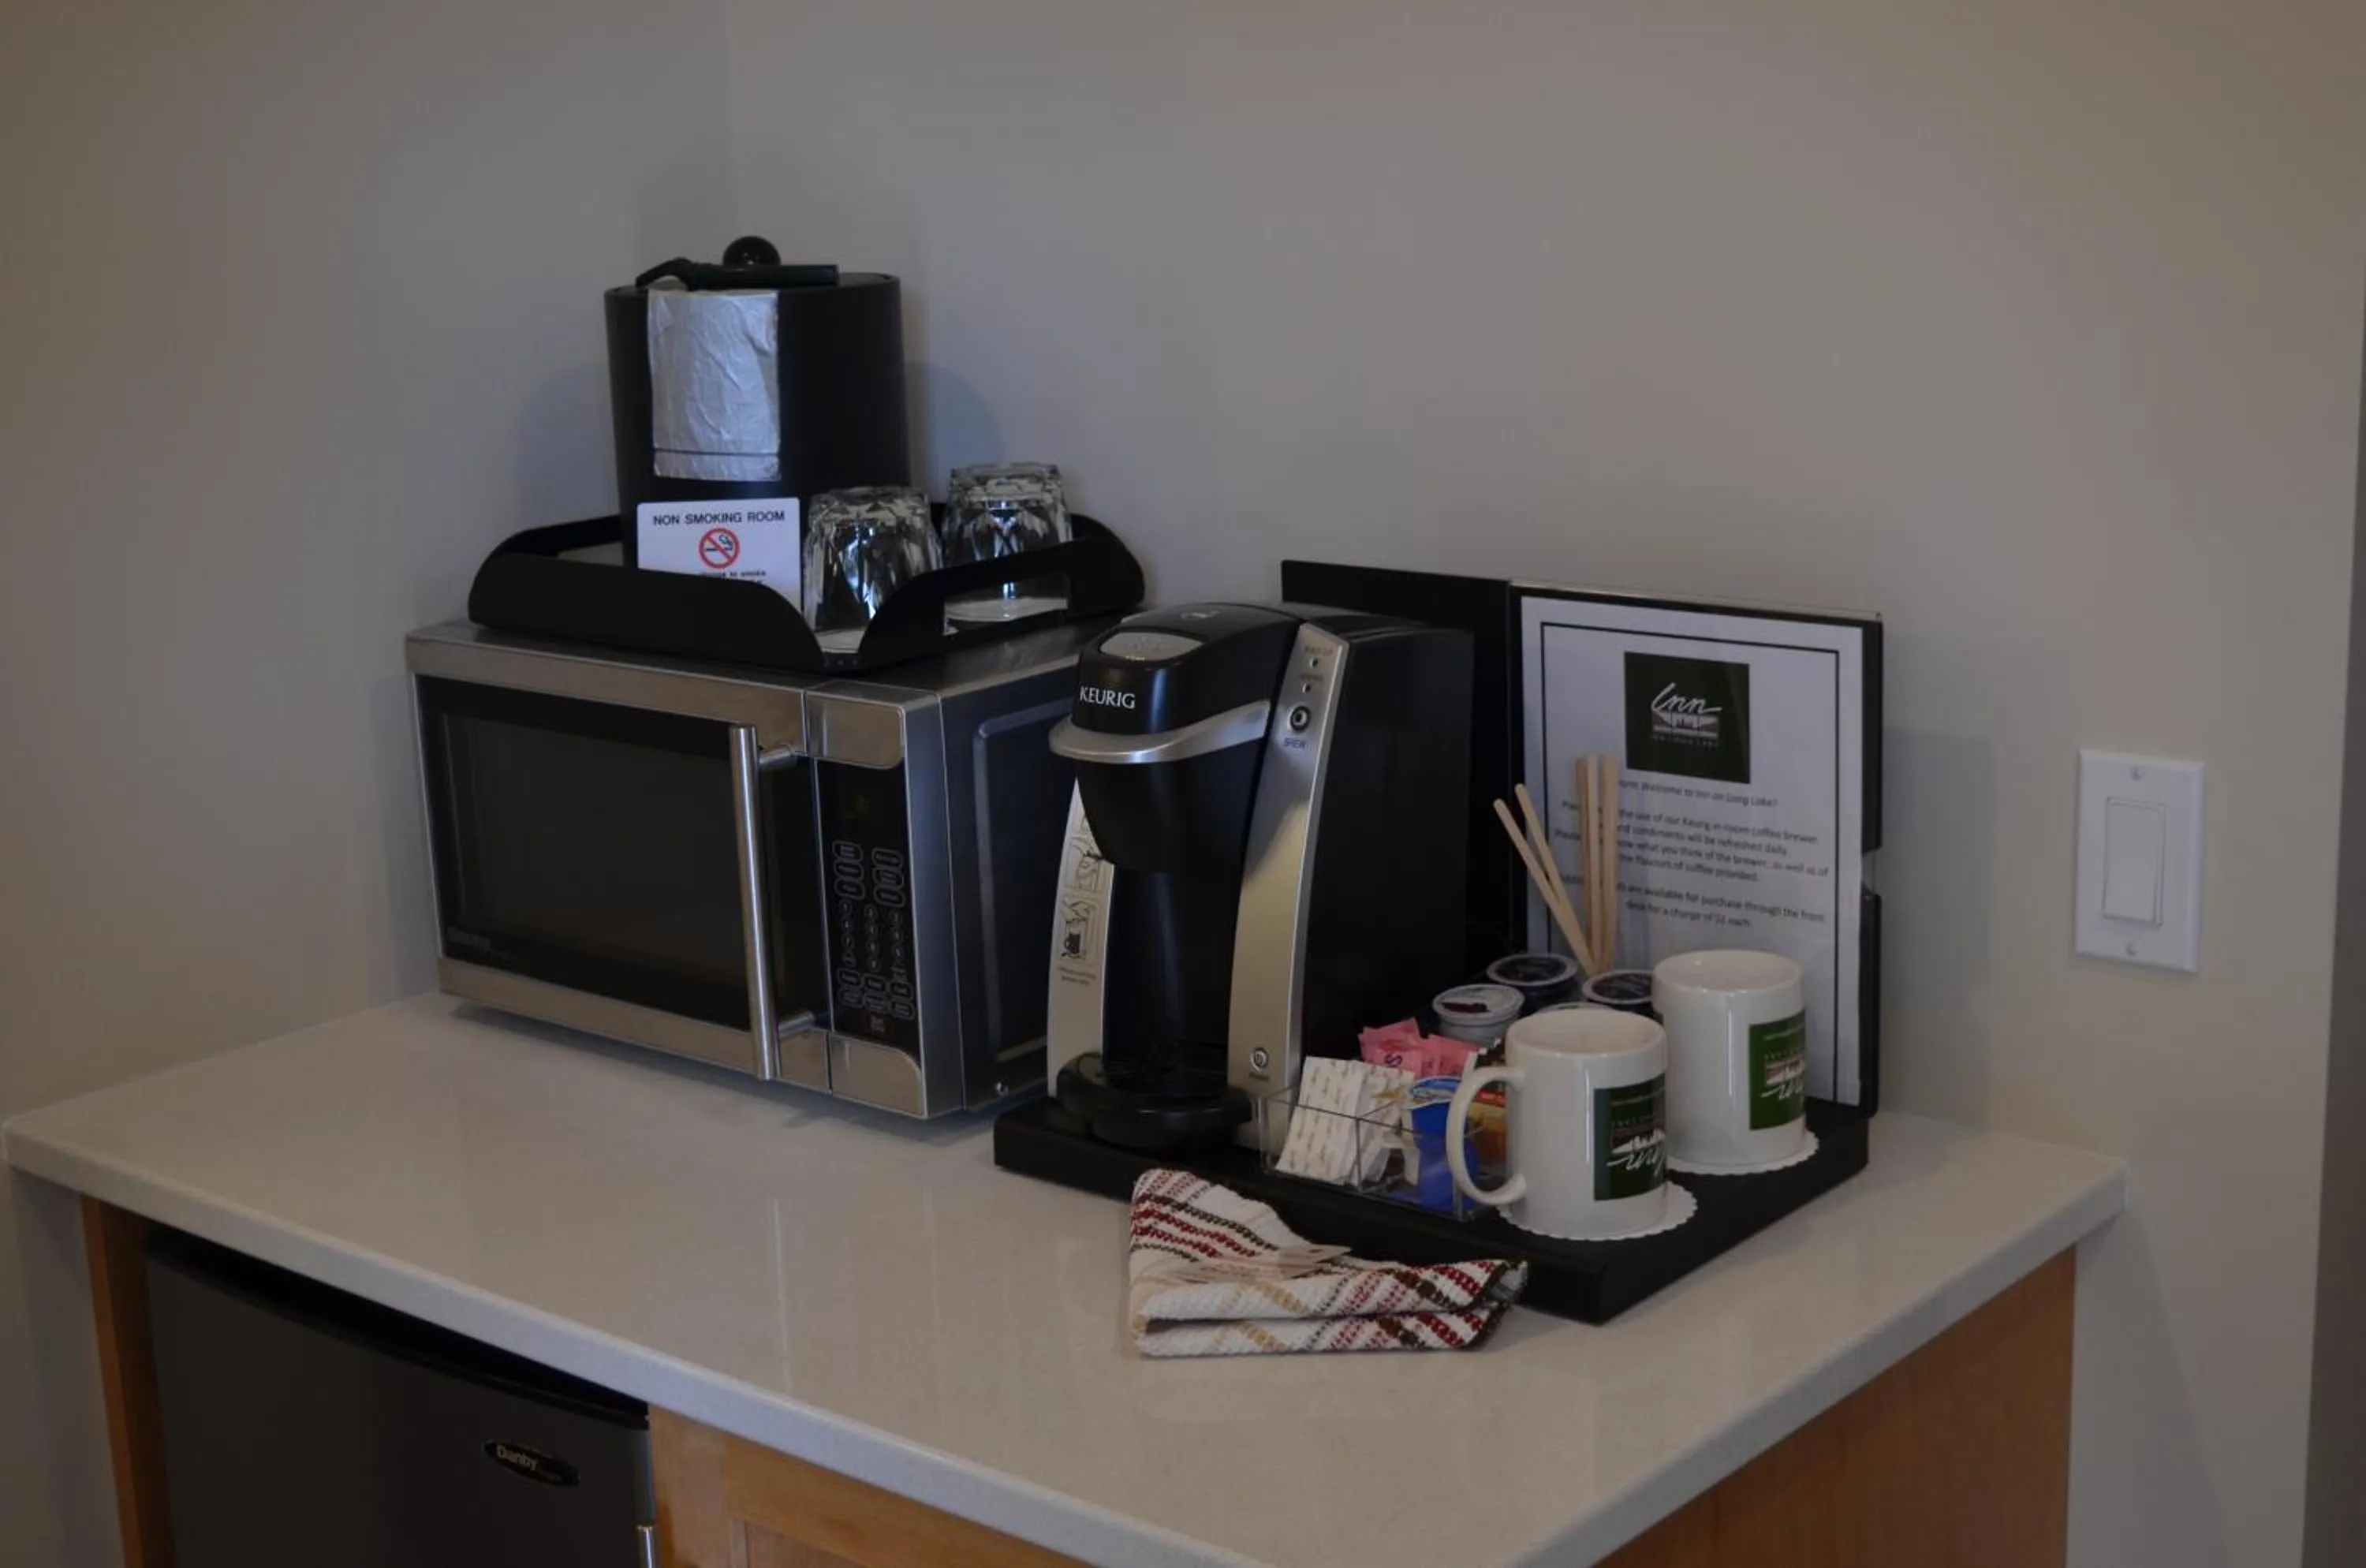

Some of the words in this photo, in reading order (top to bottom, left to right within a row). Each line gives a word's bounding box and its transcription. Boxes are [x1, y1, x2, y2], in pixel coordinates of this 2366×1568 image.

[653, 515, 680, 526] NON
[685, 512, 742, 525] SMOKING
[748, 510, 785, 522] ROOM
[1080, 685, 1136, 709] KEURIG
[1651, 681, 1722, 714] Inn
